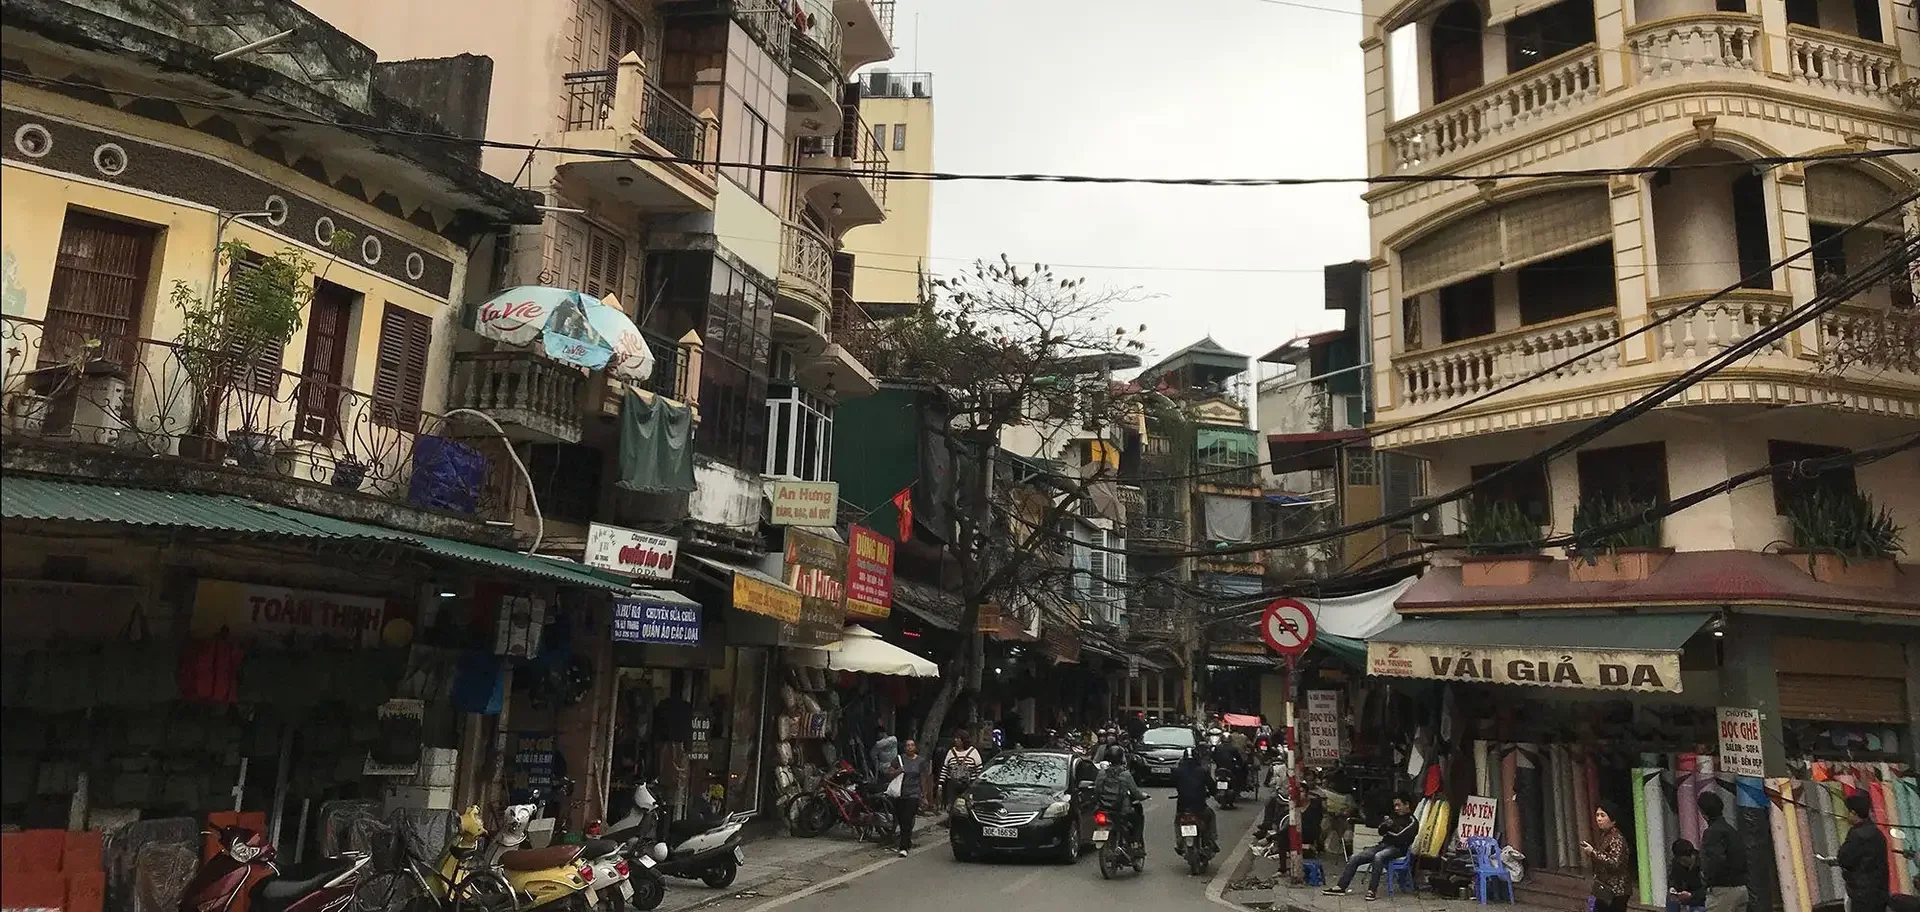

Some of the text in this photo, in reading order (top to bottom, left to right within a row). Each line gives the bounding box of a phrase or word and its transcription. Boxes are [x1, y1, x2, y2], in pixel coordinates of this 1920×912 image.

[778, 486, 832, 504] An Hưng
[646, 606, 669, 620] CHUYÊN
[671, 624, 684, 640] CÁC
[684, 627, 699, 643] LOẠI
[1388, 646, 1399, 658] 2
[1429, 651, 1664, 687] VẢI GIẢ DA
[1725, 710, 1753, 718] CHUYÊN
[1311, 725, 1337, 737] XE MÁY
[1721, 718, 1758, 742] BỌC GHẾ
[1746, 744, 1760, 754] SOFA
[1461, 801, 1495, 820] BỌC YÊN
[1460, 822, 1492, 838] XE MÁY
